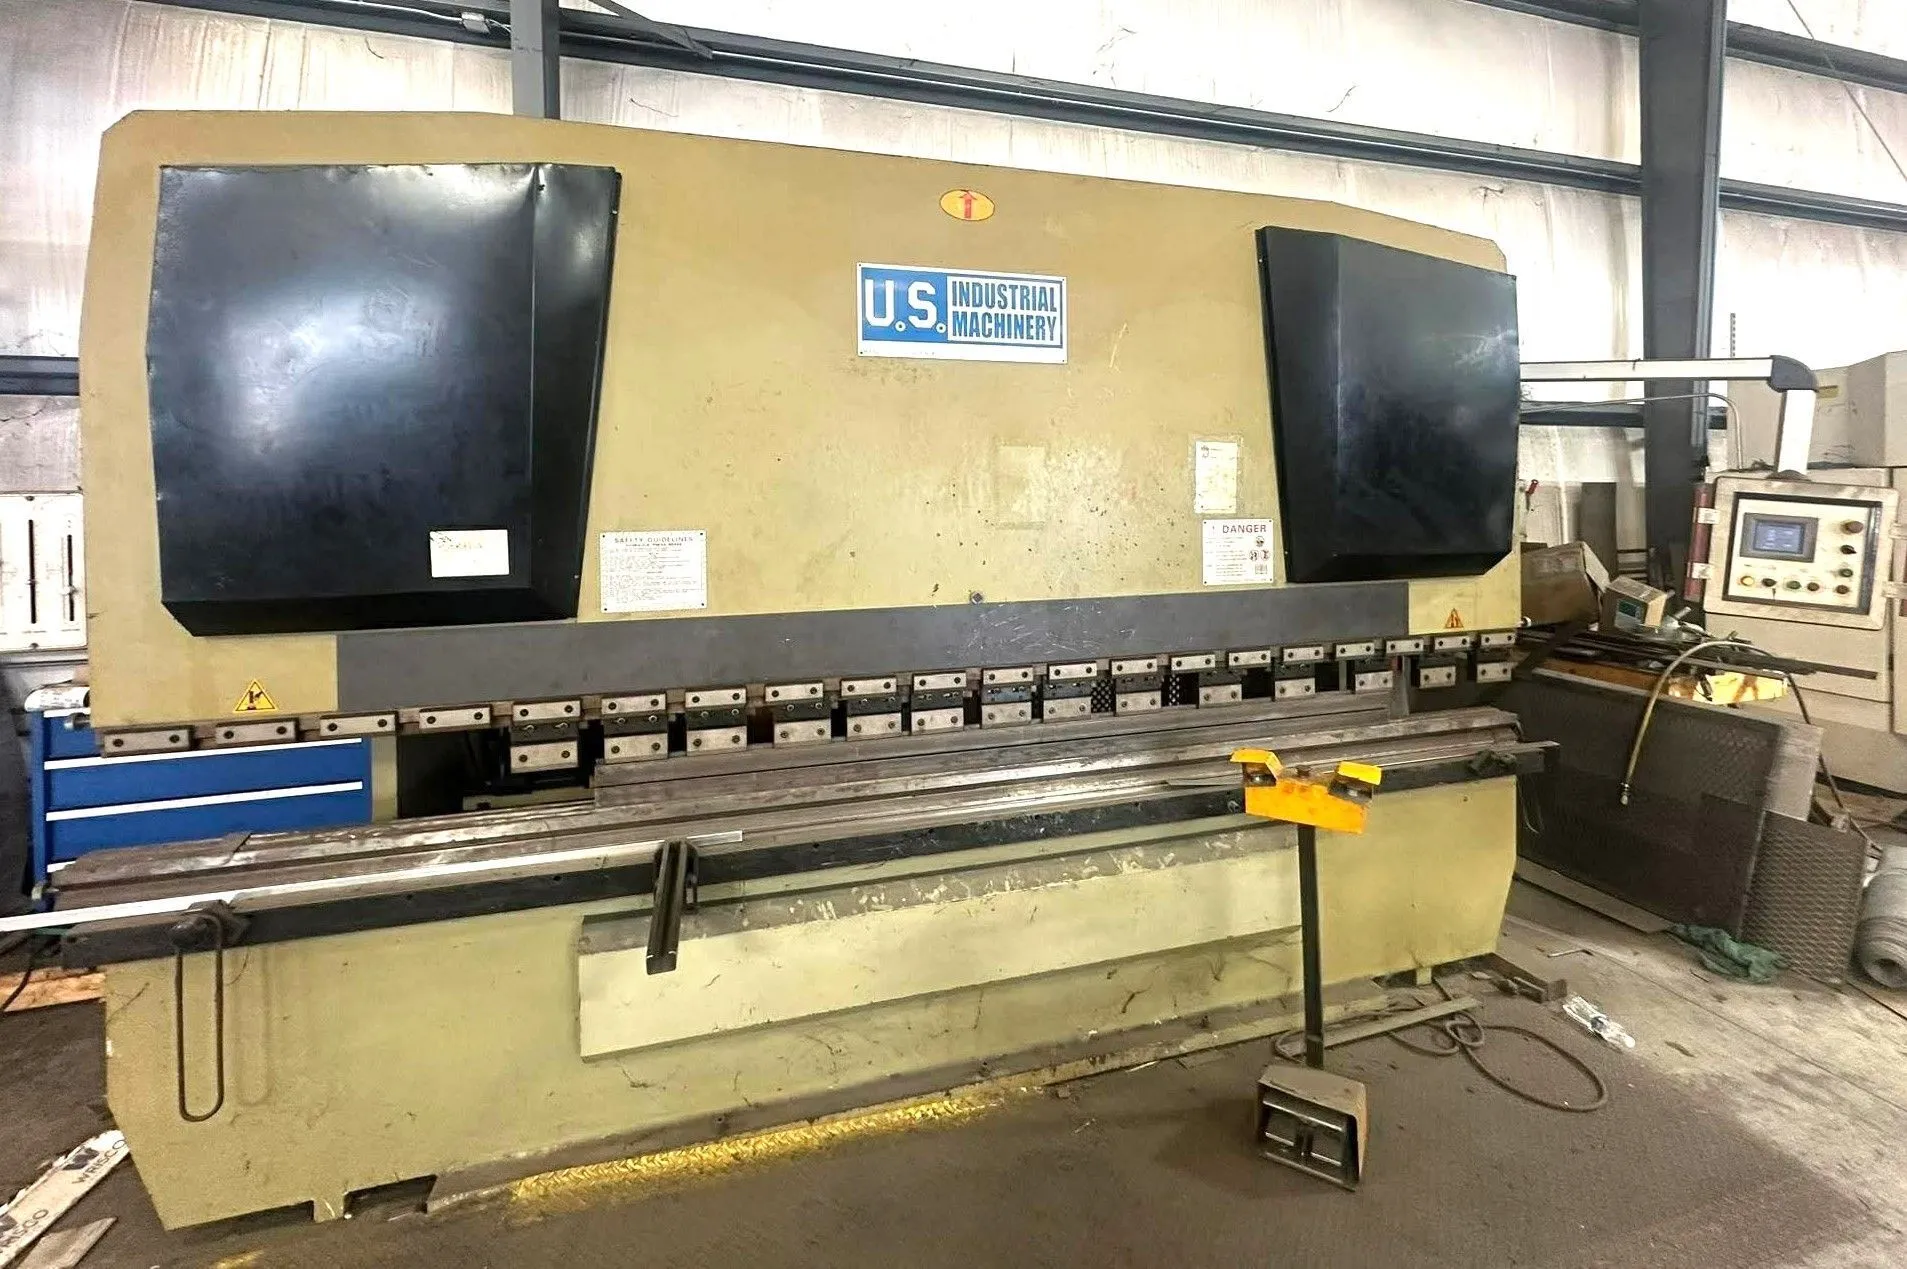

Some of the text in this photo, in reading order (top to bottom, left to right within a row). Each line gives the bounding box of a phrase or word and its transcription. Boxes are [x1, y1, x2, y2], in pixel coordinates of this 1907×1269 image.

[864, 278, 947, 334] U.S.
[951, 280, 1058, 313] INDUSTRIAL
[951, 311, 1057, 342] MACHINERY
[1222, 524, 1267, 534] DANGER
